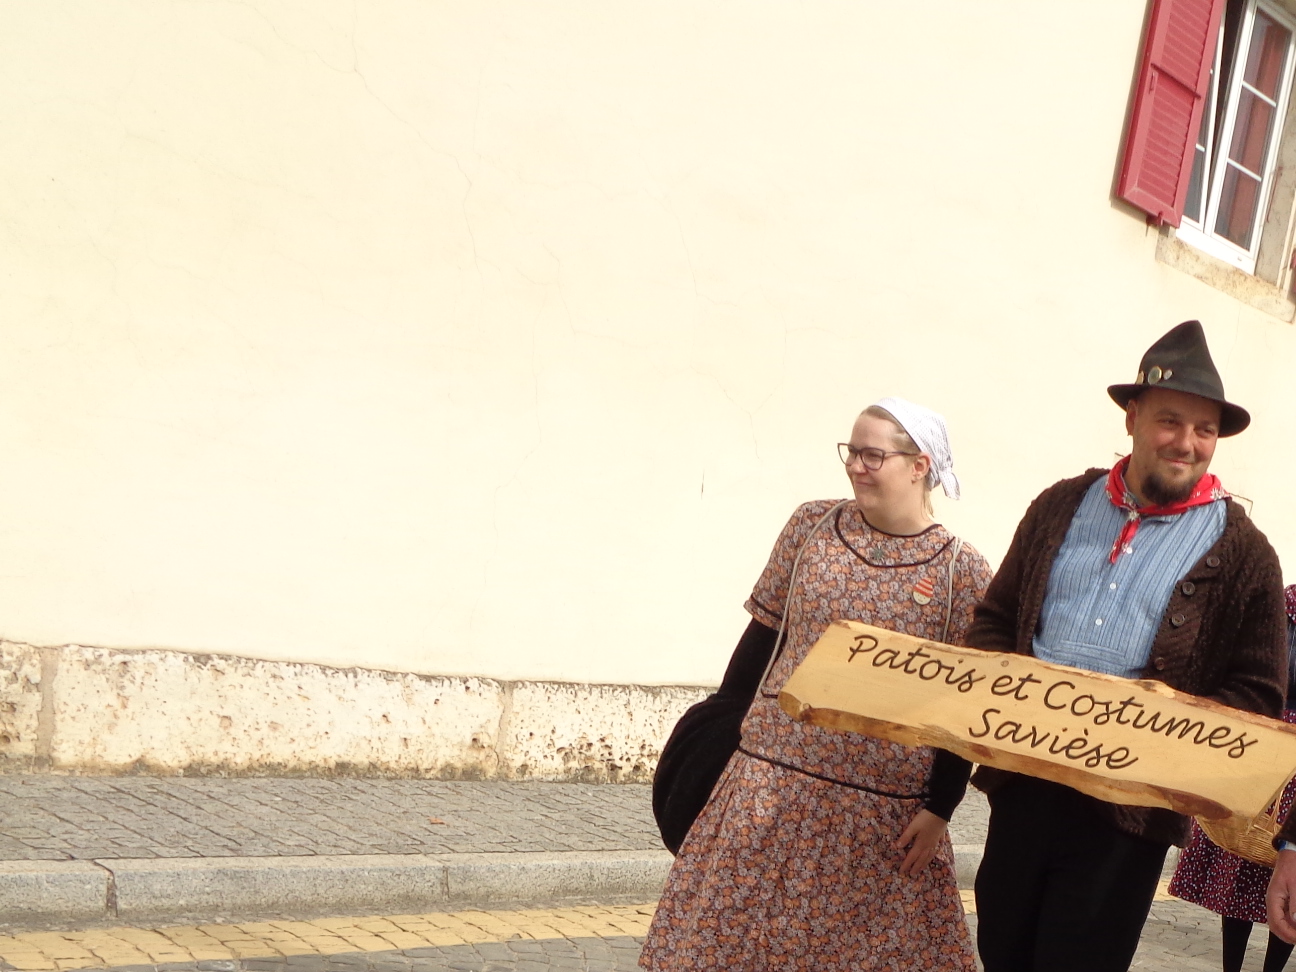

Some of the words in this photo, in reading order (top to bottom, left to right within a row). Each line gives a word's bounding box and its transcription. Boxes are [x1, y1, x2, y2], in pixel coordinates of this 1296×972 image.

[847, 634, 988, 694] Patois
[989, 672, 1042, 701] et
[1042, 681, 1258, 759] Costumes
[968, 708, 1139, 770] Savièse
